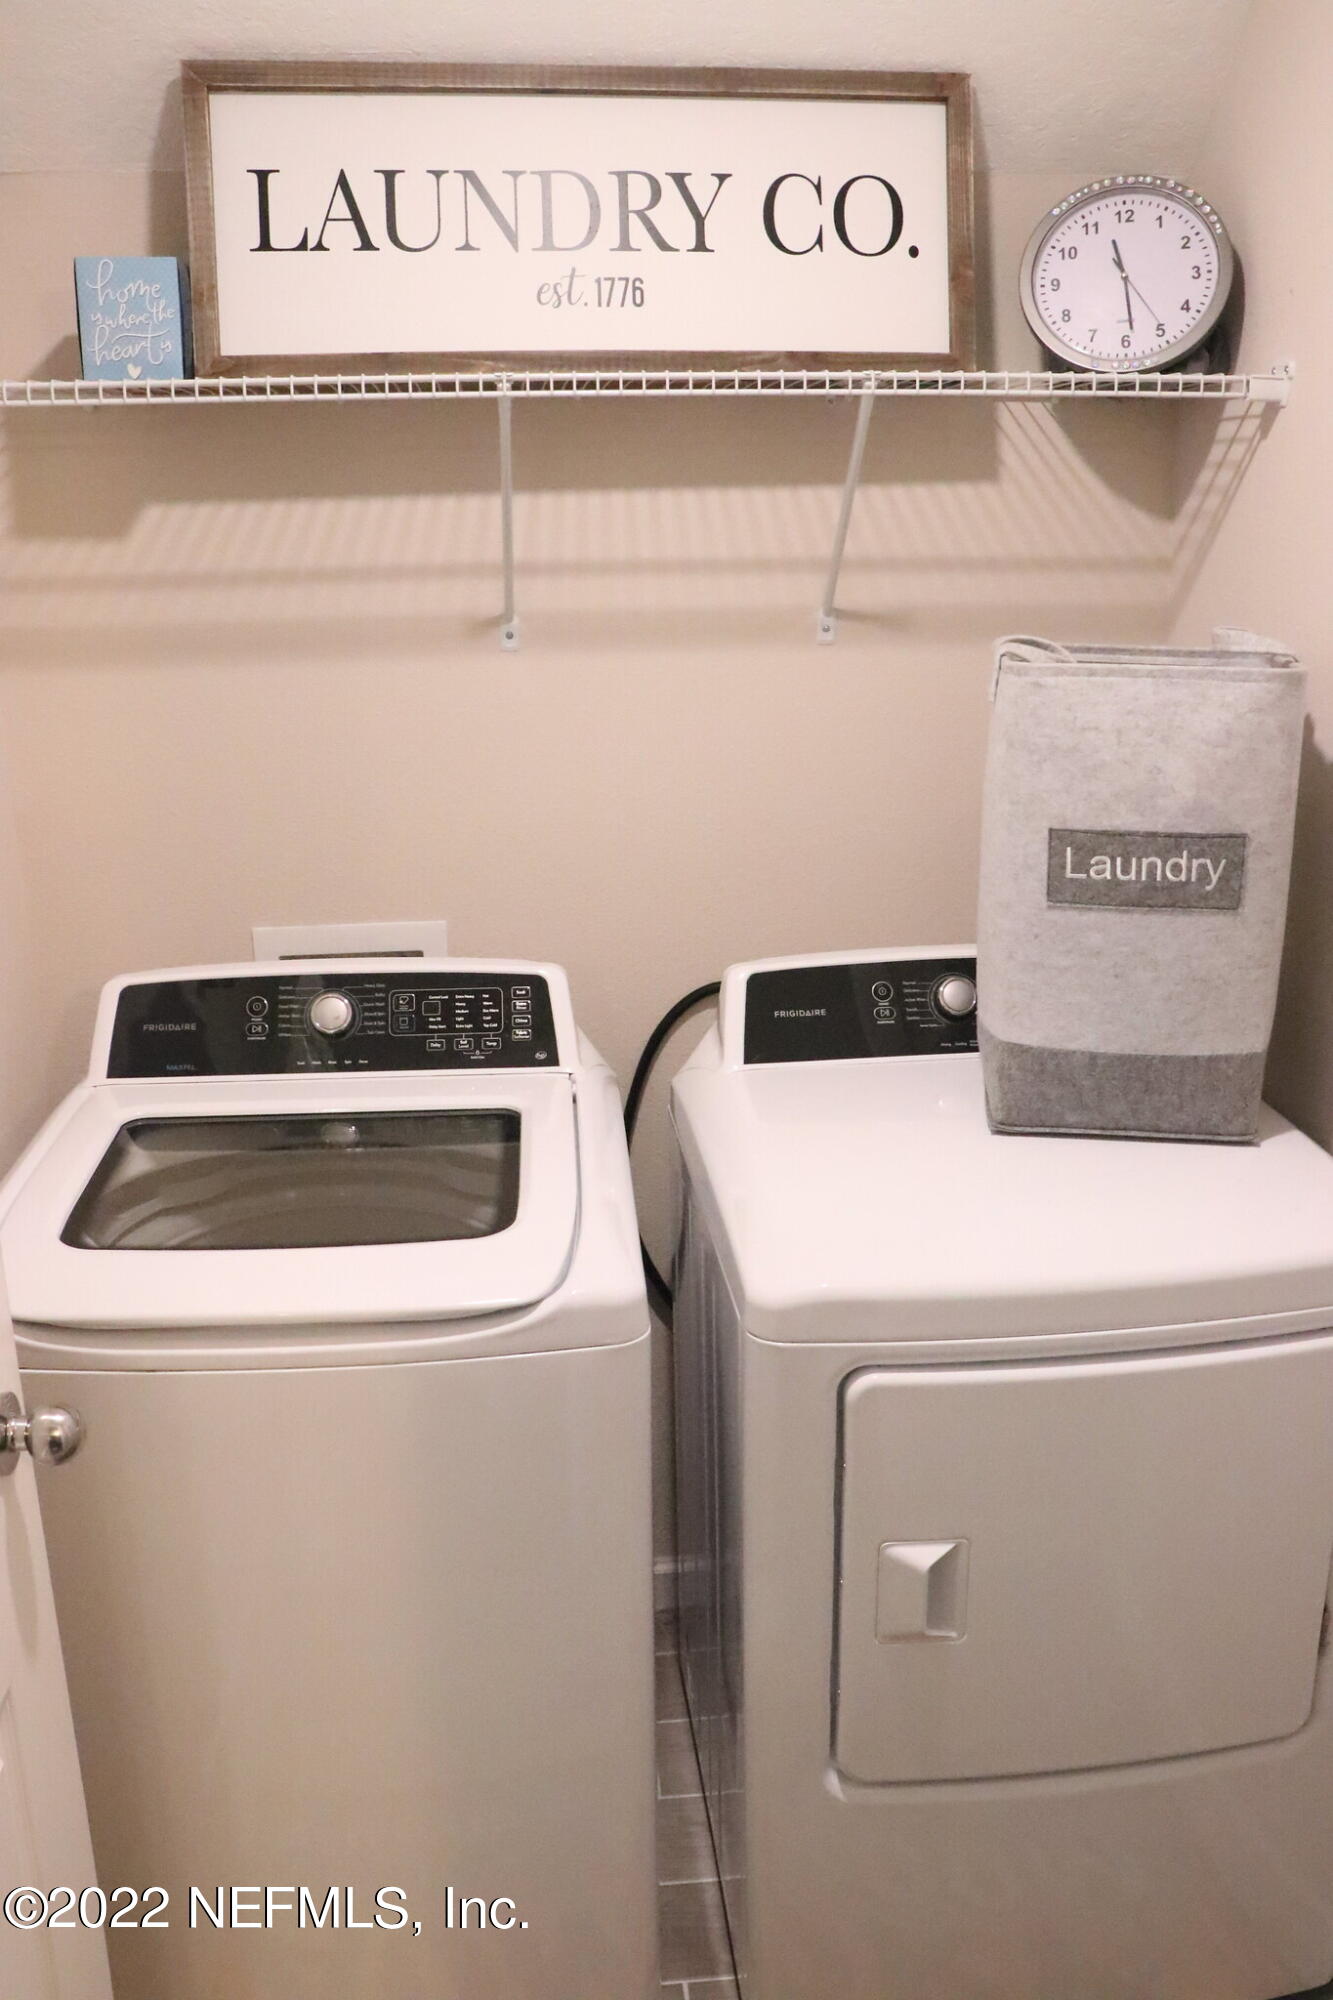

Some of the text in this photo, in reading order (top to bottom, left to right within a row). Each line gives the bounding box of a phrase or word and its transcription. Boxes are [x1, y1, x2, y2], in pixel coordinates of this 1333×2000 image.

[246, 168, 920, 259] LAUNDRY CO.
[1114, 209, 1135, 224] 12
[1081, 221, 1100, 236] 11
[1155, 215, 1164, 229] 1
[1180, 235, 1191, 250] 2
[1058, 246, 1078, 261] 10
[1191, 265, 1201, 280] 3
[86, 259, 161, 306] home
[1050, 277, 1061, 292] 9
[1180, 299, 1191, 313] 4
[1061, 308, 1072, 323] 8
[1088, 328, 1098, 343] 7
[1155, 323, 1166, 338] 5
[1120, 334, 1131, 349] 6
[1065, 846, 1227, 892] Laundry
[774, 1008, 827, 1019] FRIGIDAIRE
[143, 1023, 197, 1032] FRIGIDAIRE
